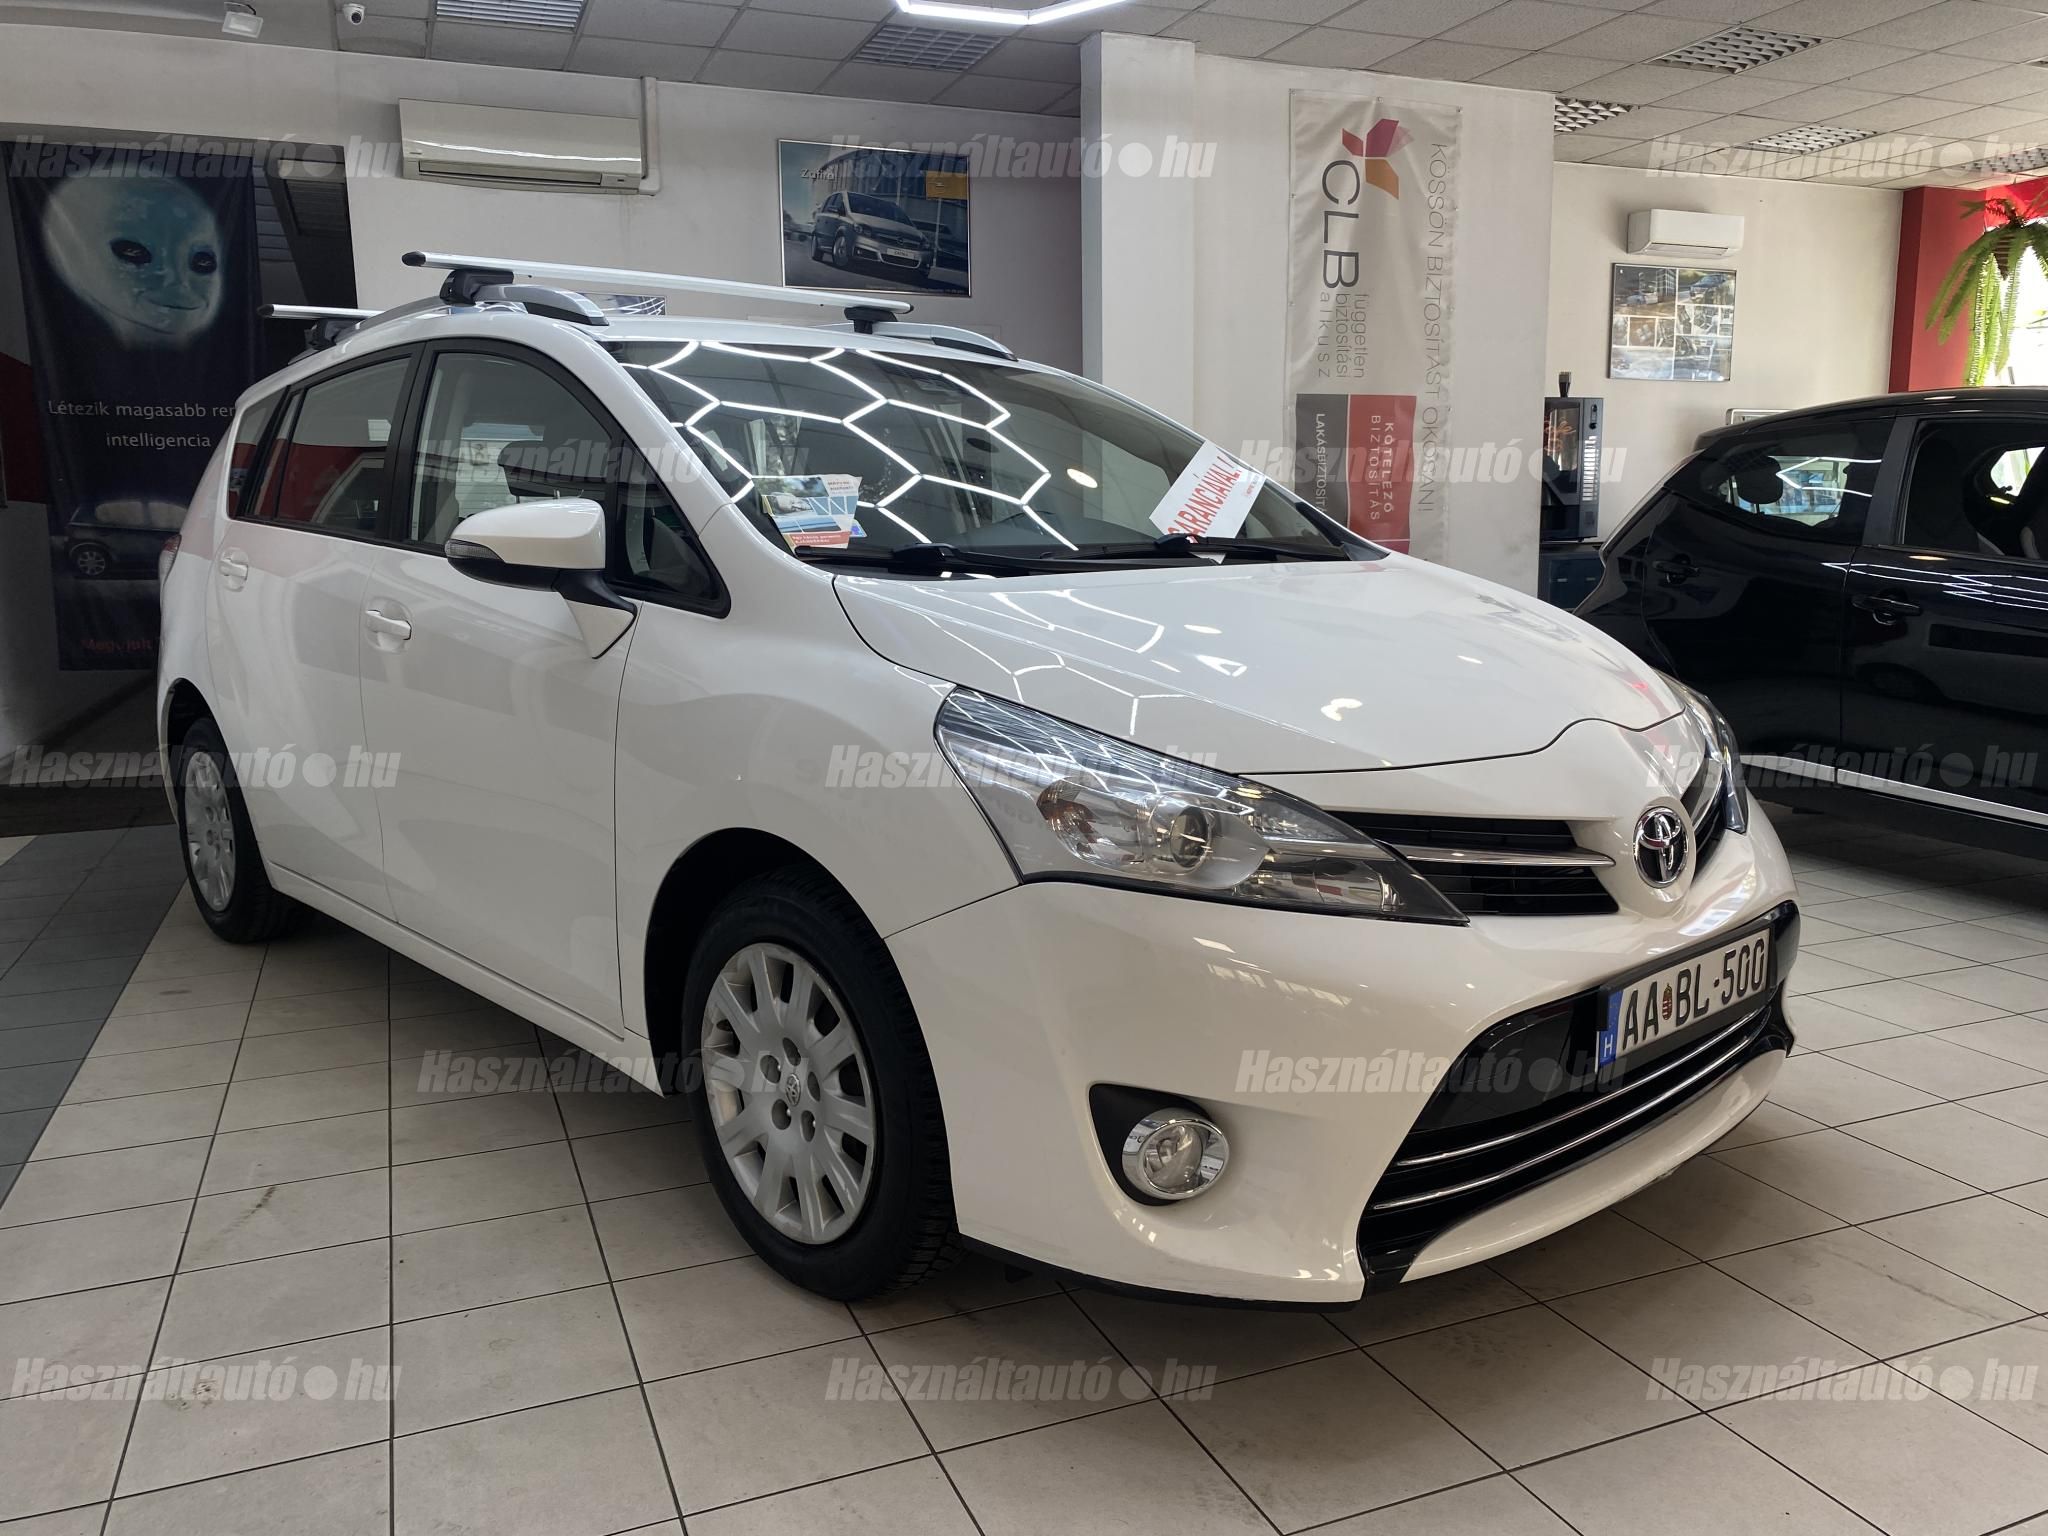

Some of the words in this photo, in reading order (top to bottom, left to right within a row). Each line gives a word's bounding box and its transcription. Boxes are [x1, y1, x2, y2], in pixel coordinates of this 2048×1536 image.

[1322, 160, 1360, 289] CLB
[1427, 143, 1450, 248] KÖSSÖN
[1335, 293, 1352, 378] biztosítási
[1350, 293, 1370, 378] független
[1423, 256, 1444, 400] BIZTOSÍTÁST
[48, 400, 110, 415] Létezik
[116, 402, 206, 420] magasabb
[106, 432, 211, 450] intelligencia
[1368, 414, 1383, 521] BIZTOSÍTÁS
[1417, 407, 1439, 512] OKOSAN!
[1603, 1033, 1614, 1058] H
